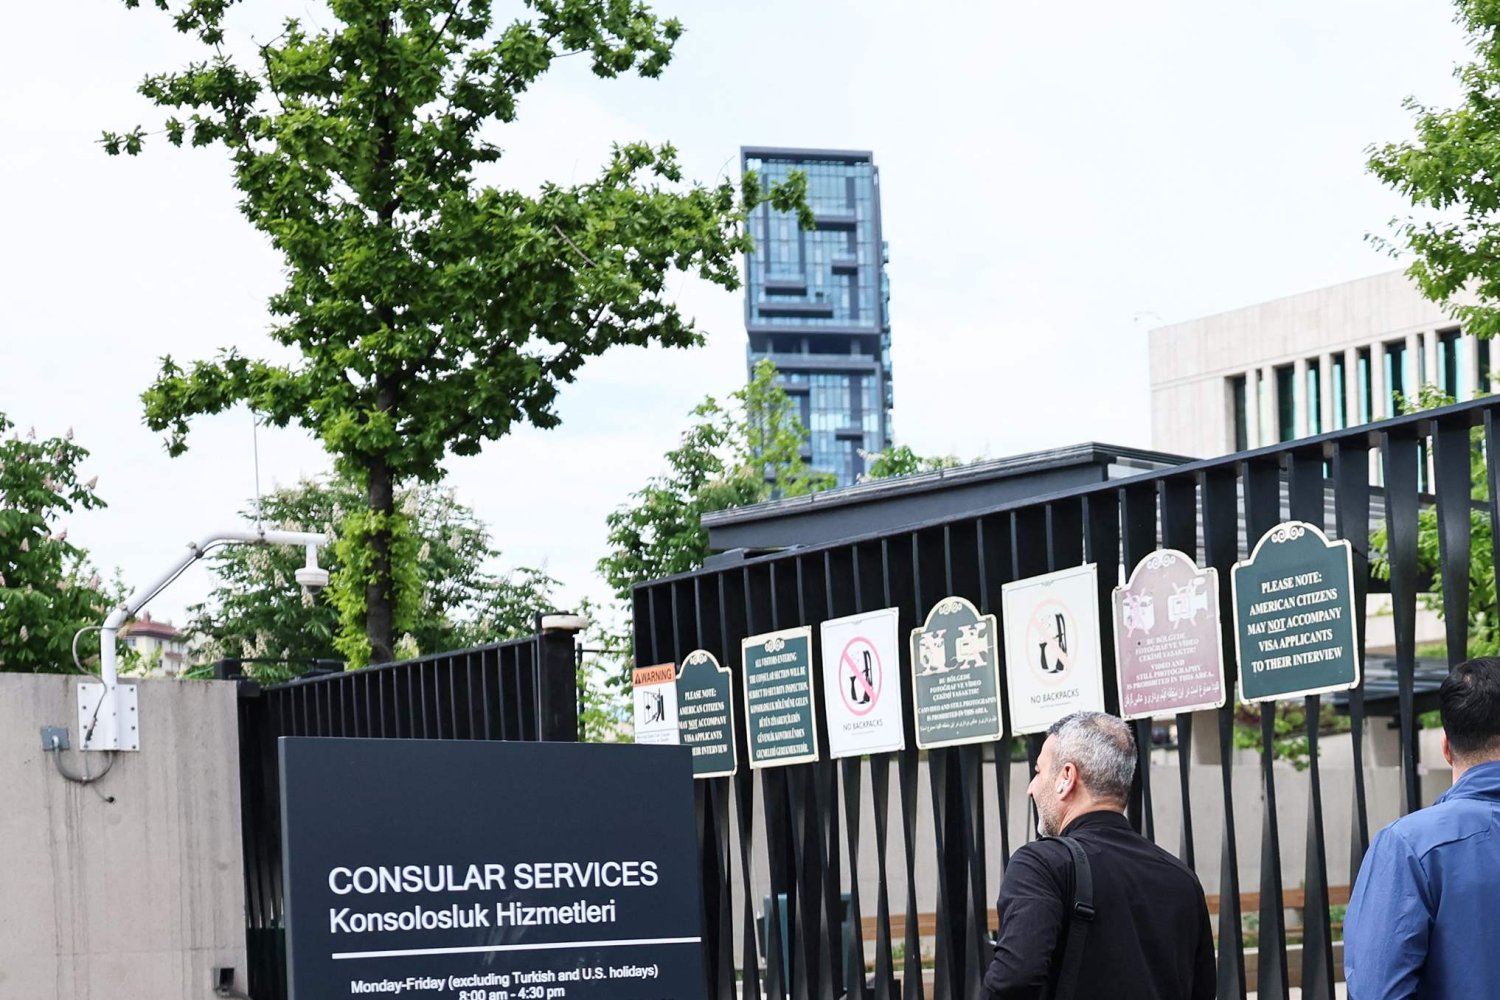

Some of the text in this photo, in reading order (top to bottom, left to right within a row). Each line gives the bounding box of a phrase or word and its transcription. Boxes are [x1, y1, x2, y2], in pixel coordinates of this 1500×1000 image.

[1262, 572, 1322, 593] PLEASE NOTE:
[1250, 588, 1337, 616] AMERICAN CITIZENS
[1248, 607, 1341, 635] MAY NOT ACCOMPANY
[1259, 629, 1333, 652] VISA APPLICANTS
[1252, 647, 1342, 672] TO THEIR INTERVIEW
[641, 669, 671, 682] WARNING
[684, 690, 700, 700] PLEASE
[1031, 689, 1079, 704] NO BACKPACKS
[843, 719, 883, 731] NO BACKPACKS
[328, 861, 657, 894] CONSULAR SERVICES
[330, 899, 614, 932] Konsolosluk Hizmetleri
[351, 964, 658, 993] Monday-Friday (excluding Turkish and U.S. holidays)
[488, 991, 507, 1000] am
[517, 986, 543, 998] 4:30
[546, 987, 564, 999] pm
